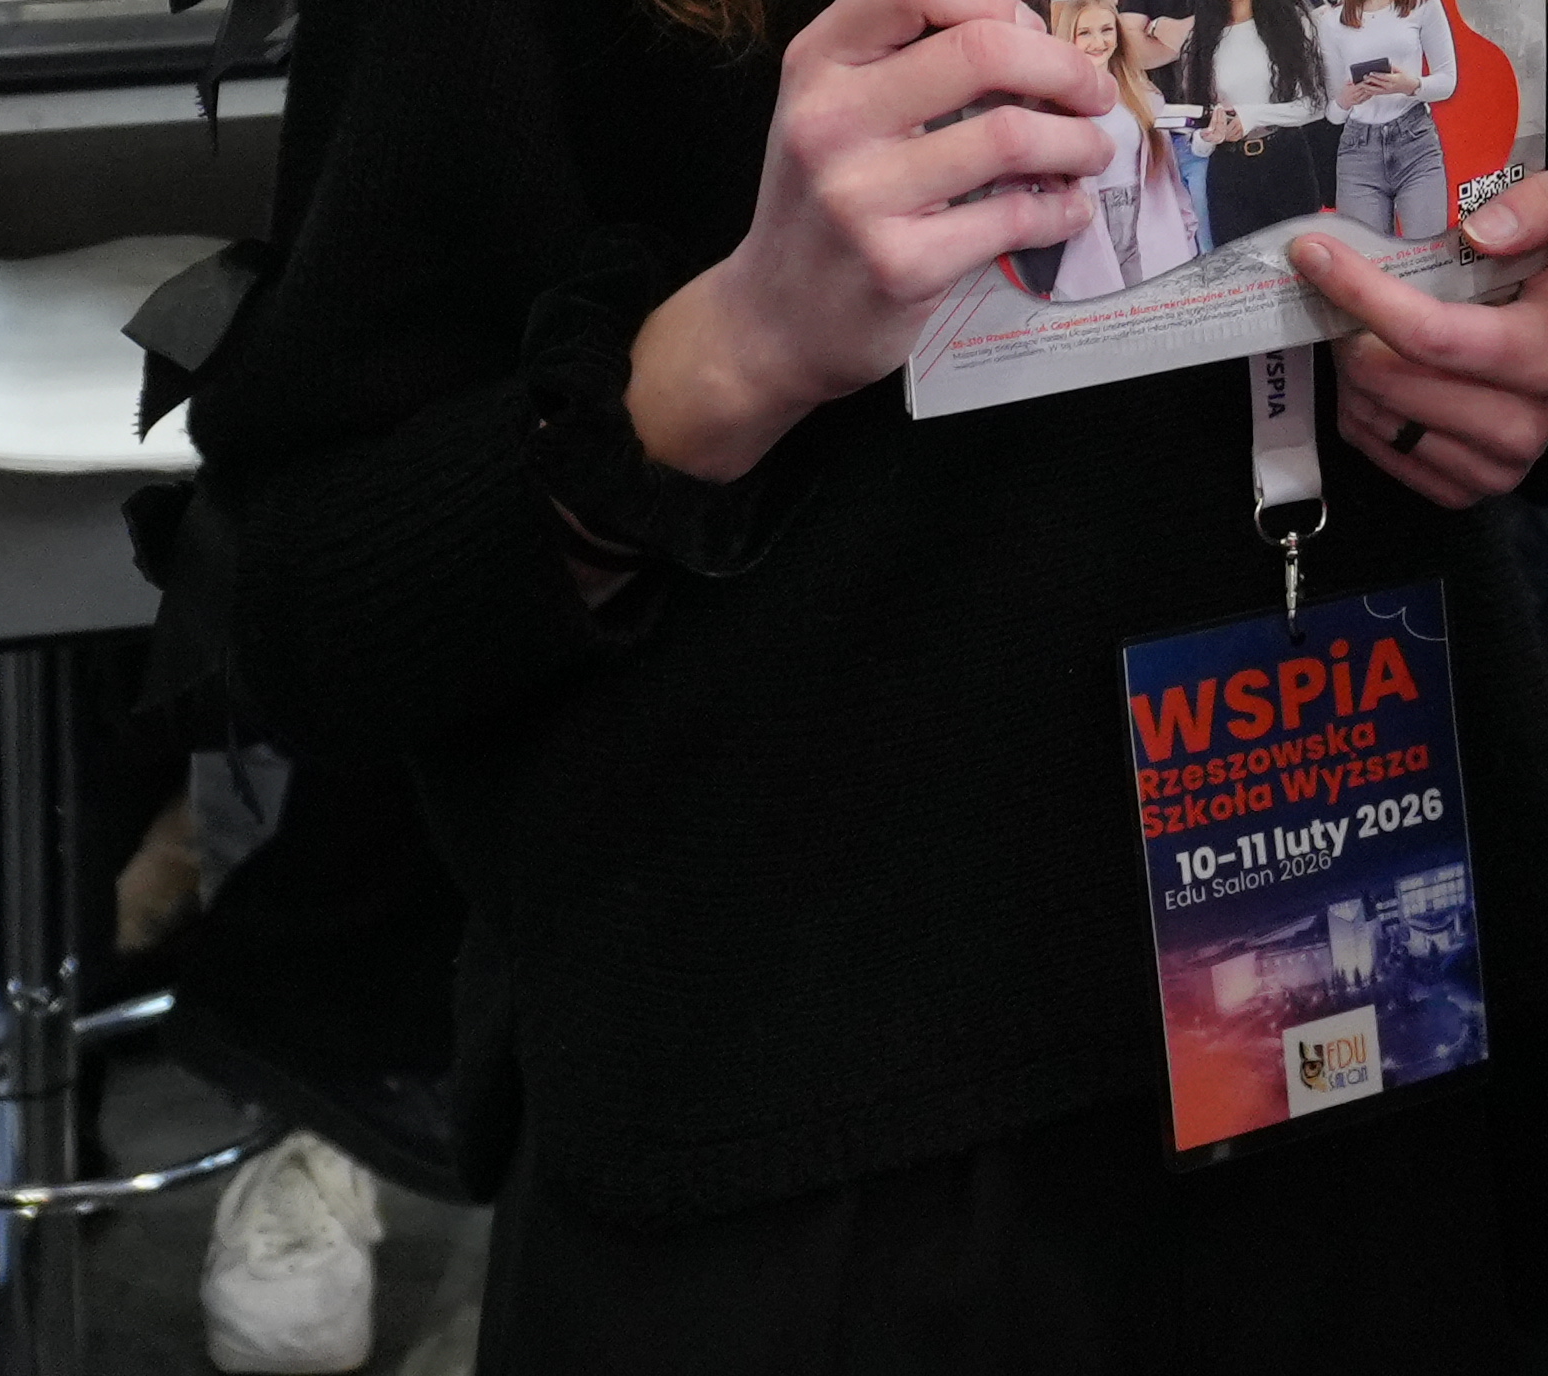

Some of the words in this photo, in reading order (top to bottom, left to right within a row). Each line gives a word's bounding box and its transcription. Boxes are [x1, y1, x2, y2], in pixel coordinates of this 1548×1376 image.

[1131, 637, 1419, 762] WSPiA
[1138, 718, 1377, 803] Rzeszowska
[1143, 781, 1274, 840] Szkoła
[1280, 739, 1430, 809] Wyższa
[1275, 811, 1350, 861] luty
[1357, 787, 1445, 835] 2026
[1164, 880, 1208, 911] Edu
[1212, 864, 1275, 897] Salon
[1279, 850, 1333, 882] 2026
[1327, 1033, 1367, 1071] EDU
